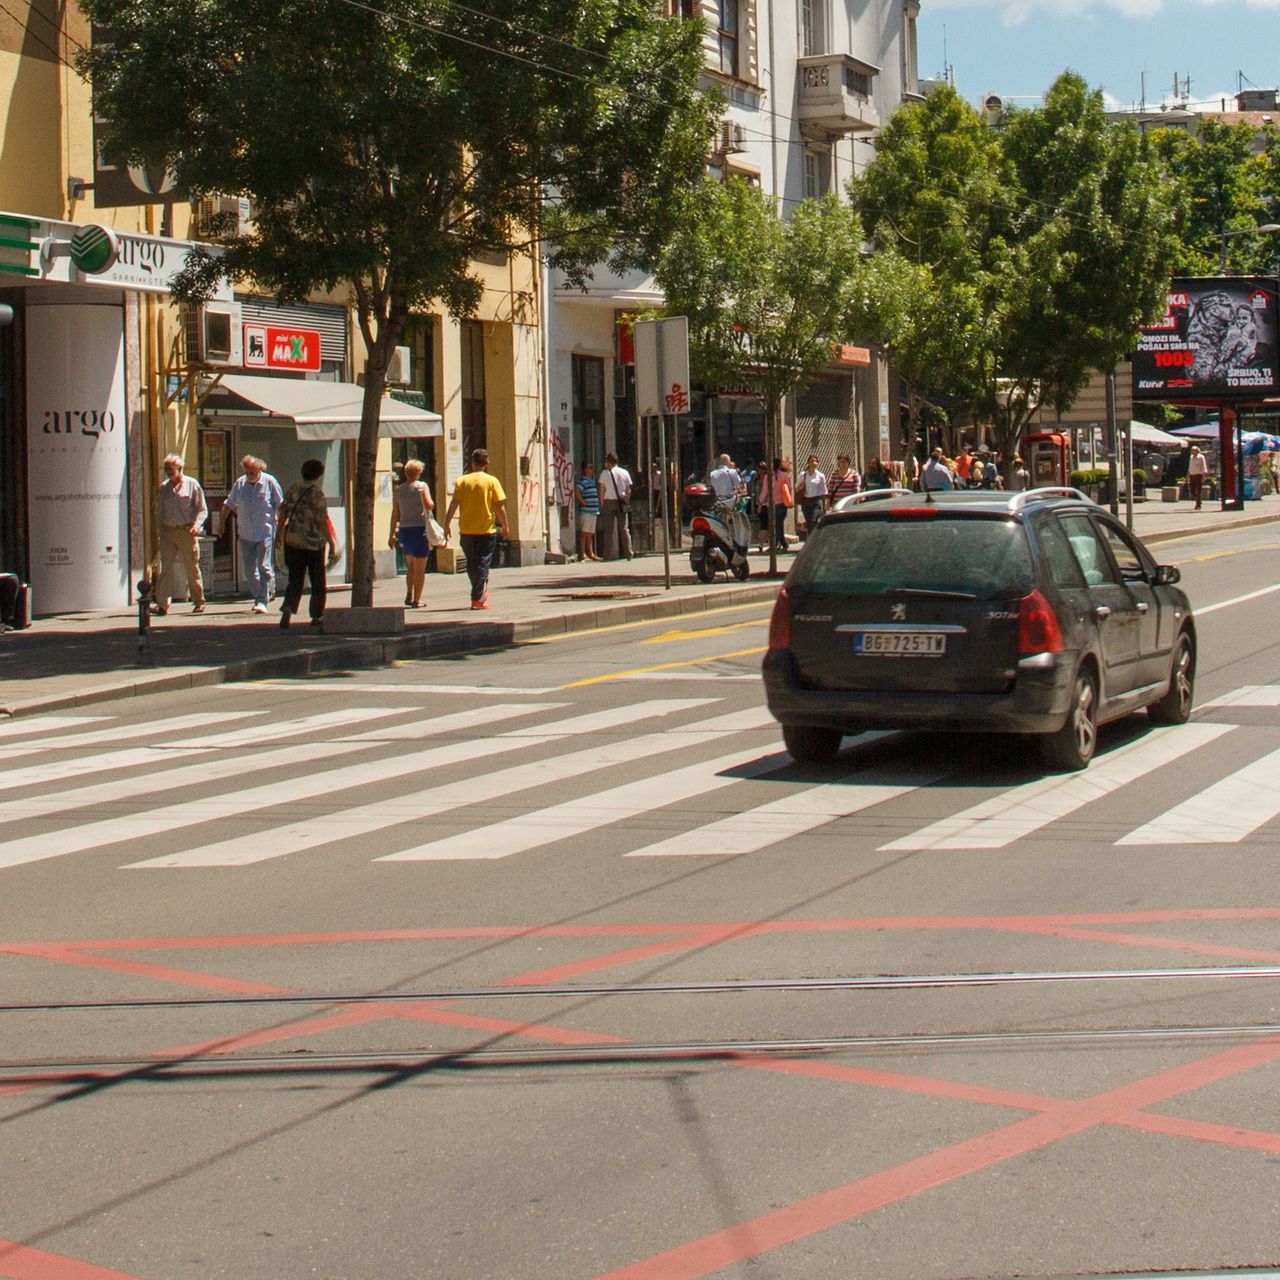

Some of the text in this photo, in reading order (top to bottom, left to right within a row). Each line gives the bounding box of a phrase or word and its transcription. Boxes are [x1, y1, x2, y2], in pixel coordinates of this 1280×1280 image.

[117, 239, 165, 274] argo
[272, 335, 308, 364] MAXI
[1170, 343, 1187, 351] SMS
[1154, 352, 1193, 367] 1003
[1139, 380, 1164, 388] Kurir
[1226, 378, 1238, 386] TO
[43, 410, 115, 439] argo
[864, 635, 882, 651] BG
